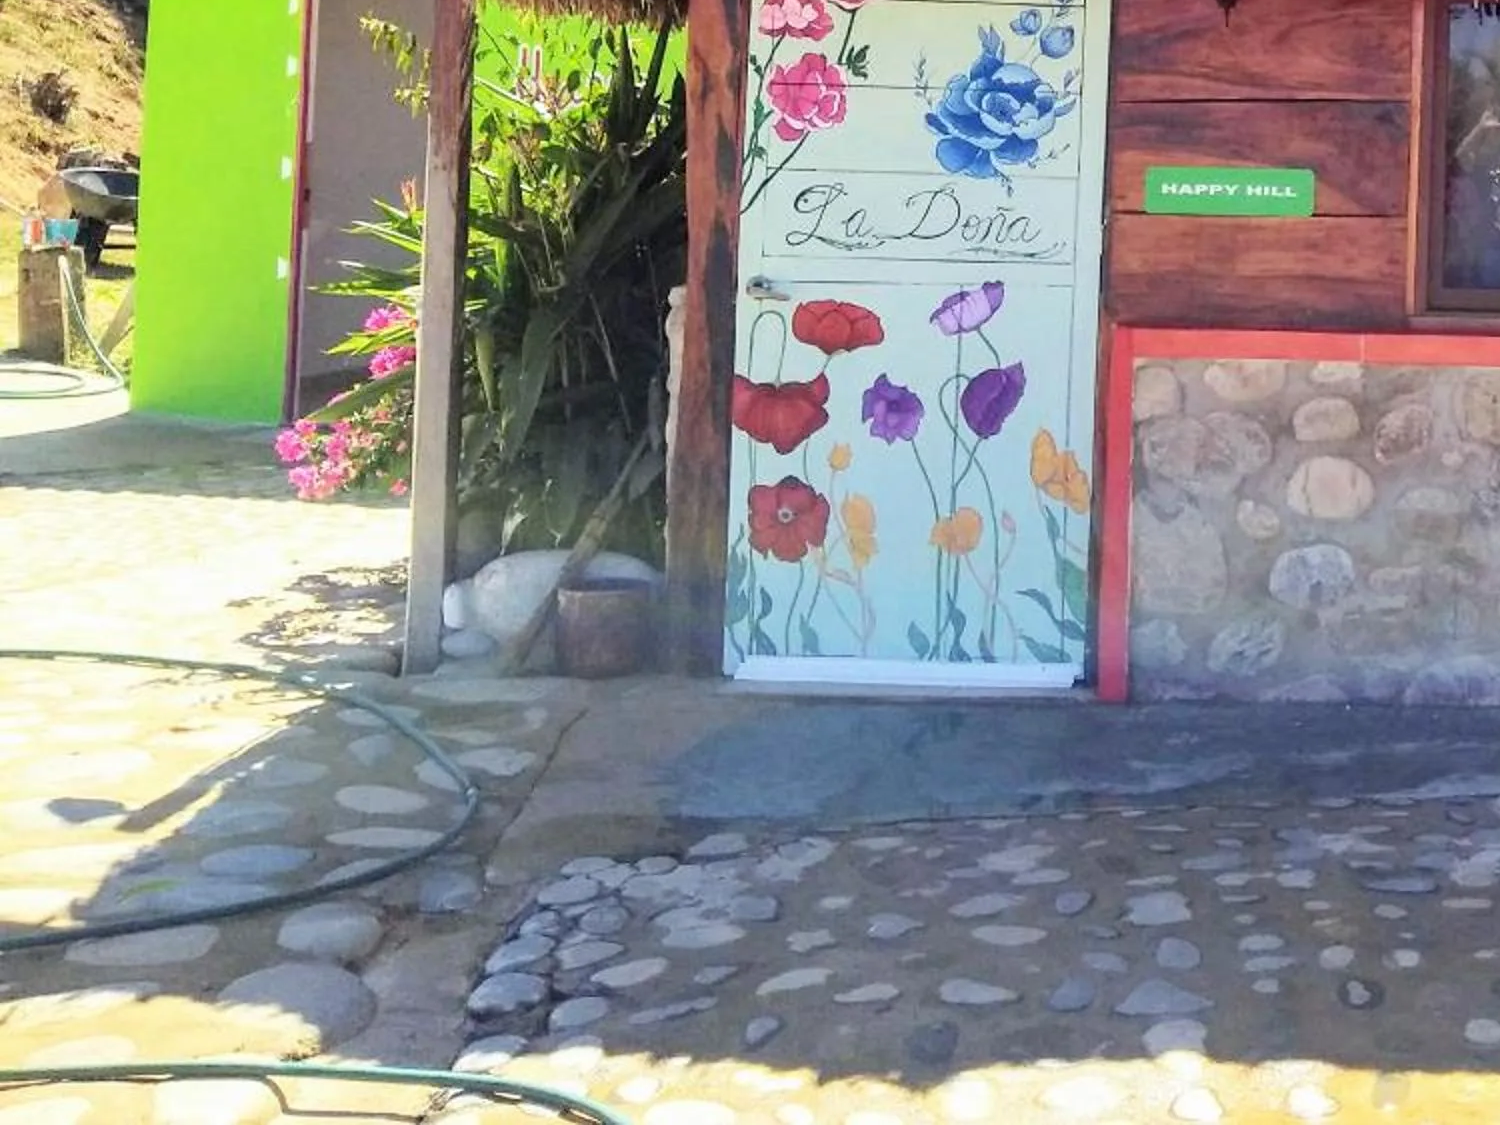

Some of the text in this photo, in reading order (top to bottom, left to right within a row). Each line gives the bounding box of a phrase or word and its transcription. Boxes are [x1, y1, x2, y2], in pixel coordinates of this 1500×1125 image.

[1161, 183, 1297, 197] HAPPY HILL
[786, 182, 1041, 250] La Doña
